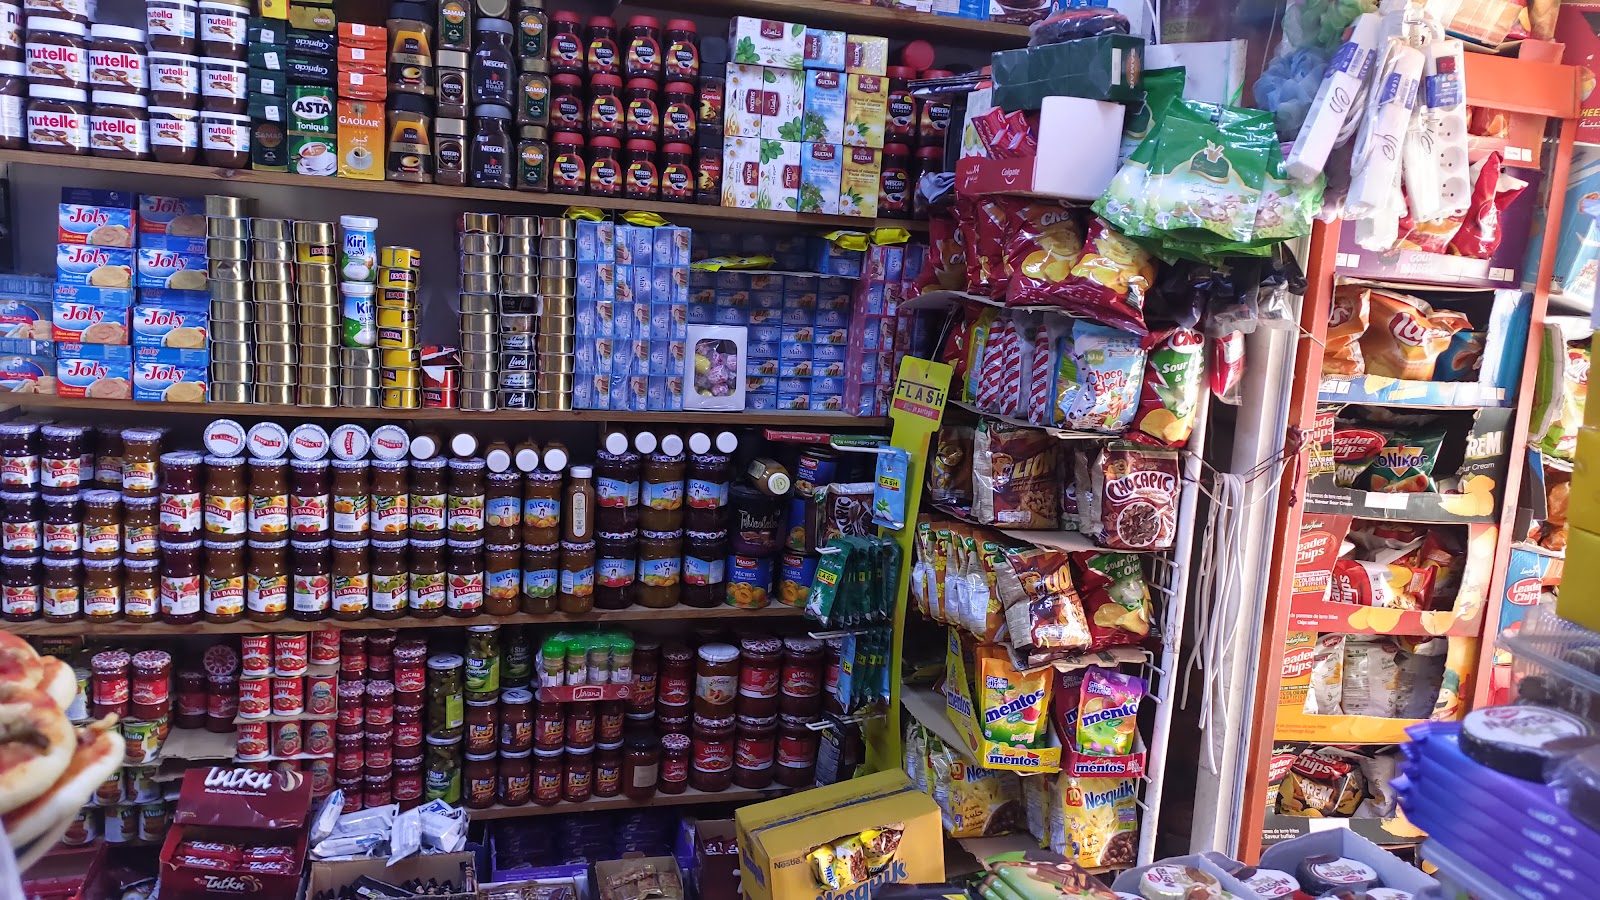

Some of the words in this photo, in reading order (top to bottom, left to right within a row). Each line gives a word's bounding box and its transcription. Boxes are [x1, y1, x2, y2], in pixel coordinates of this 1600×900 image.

[442, 8, 466, 17] SAMAR
[207, 16, 238, 28] nutella
[520, 22, 543, 30] SAMAR
[26, 48, 78, 63] nutella
[90, 54, 140, 70] nutella
[158, 67, 189, 77] nutella
[208, 72, 238, 82] nutella
[525, 86, 548, 94] SAMAR
[859, 82, 878, 90] SULTAN
[295, 102, 332, 114] ASTA
[28, 114, 79, 130] nutella
[91, 120, 136, 135] nutella
[155, 120, 186, 131] nutella
[297, 122, 328, 132] Tonique
[338, 116, 379, 128] GAOUAR
[208, 126, 238, 136] nutella
[522, 152, 544, 160] SAMAR
[1002, 168, 1021, 177] Colgate
[150, 198, 188, 216] Joly
[70, 208, 110, 226] Joly
[346, 234, 366, 248] Kiri
[68, 248, 110, 267] Joly
[148, 254, 188, 270] Joly
[391, 272, 413, 280] ISABEL
[386, 292, 410, 300] ISABEL
[63, 306, 104, 324] Joly
[144, 310, 185, 328] Joly
[68, 362, 109, 380] Joly
[1162, 362, 1188, 374] Sour
[144, 366, 186, 384] Joly
[1088, 369, 1122, 386] Choco
[1174, 374, 1182, 383] &
[1094, 378, 1128, 396] Shells
[897, 380, 944, 407] FLASH
[1334, 436, 1376, 446] eader
[1466, 431, 1502, 456] REM
[1334, 444, 1366, 456] hips
[1472, 462, 1495, 470] Cream
[880, 477, 898, 488] LASH
[1109, 473, 1176, 498] CHOCAPIC
[418, 508, 441, 516] BARAKA
[458, 508, 480, 517] BARAKA
[1298, 536, 1328, 551] eader
[1104, 558, 1126, 574] Sour
[1044, 565, 1071, 593] LIO
[336, 588, 344, 596] EL
[1284, 650, 1318, 666] eader
[1282, 660, 1312, 675] Chips
[948, 692, 971, 717] mentos
[986, 690, 1045, 722] mentos
[988, 755, 1040, 766] mentos
[1270, 758, 1291, 770] ader
[1294, 756, 1332, 774] Chips
[1076, 763, 1125, 773] mentos
[429, 771, 444, 779] Star
[1084, 780, 1135, 810] Nesquik
[192, 841, 224, 852] Tutku
[252, 847, 284, 856] Tutku
[185, 856, 217, 865] Tutku
[250, 862, 281, 870] Tutku
[1323, 868, 1367, 878] MASTER
[204, 875, 246, 891] Tutku
[1256, 878, 1290, 894] MASTER
